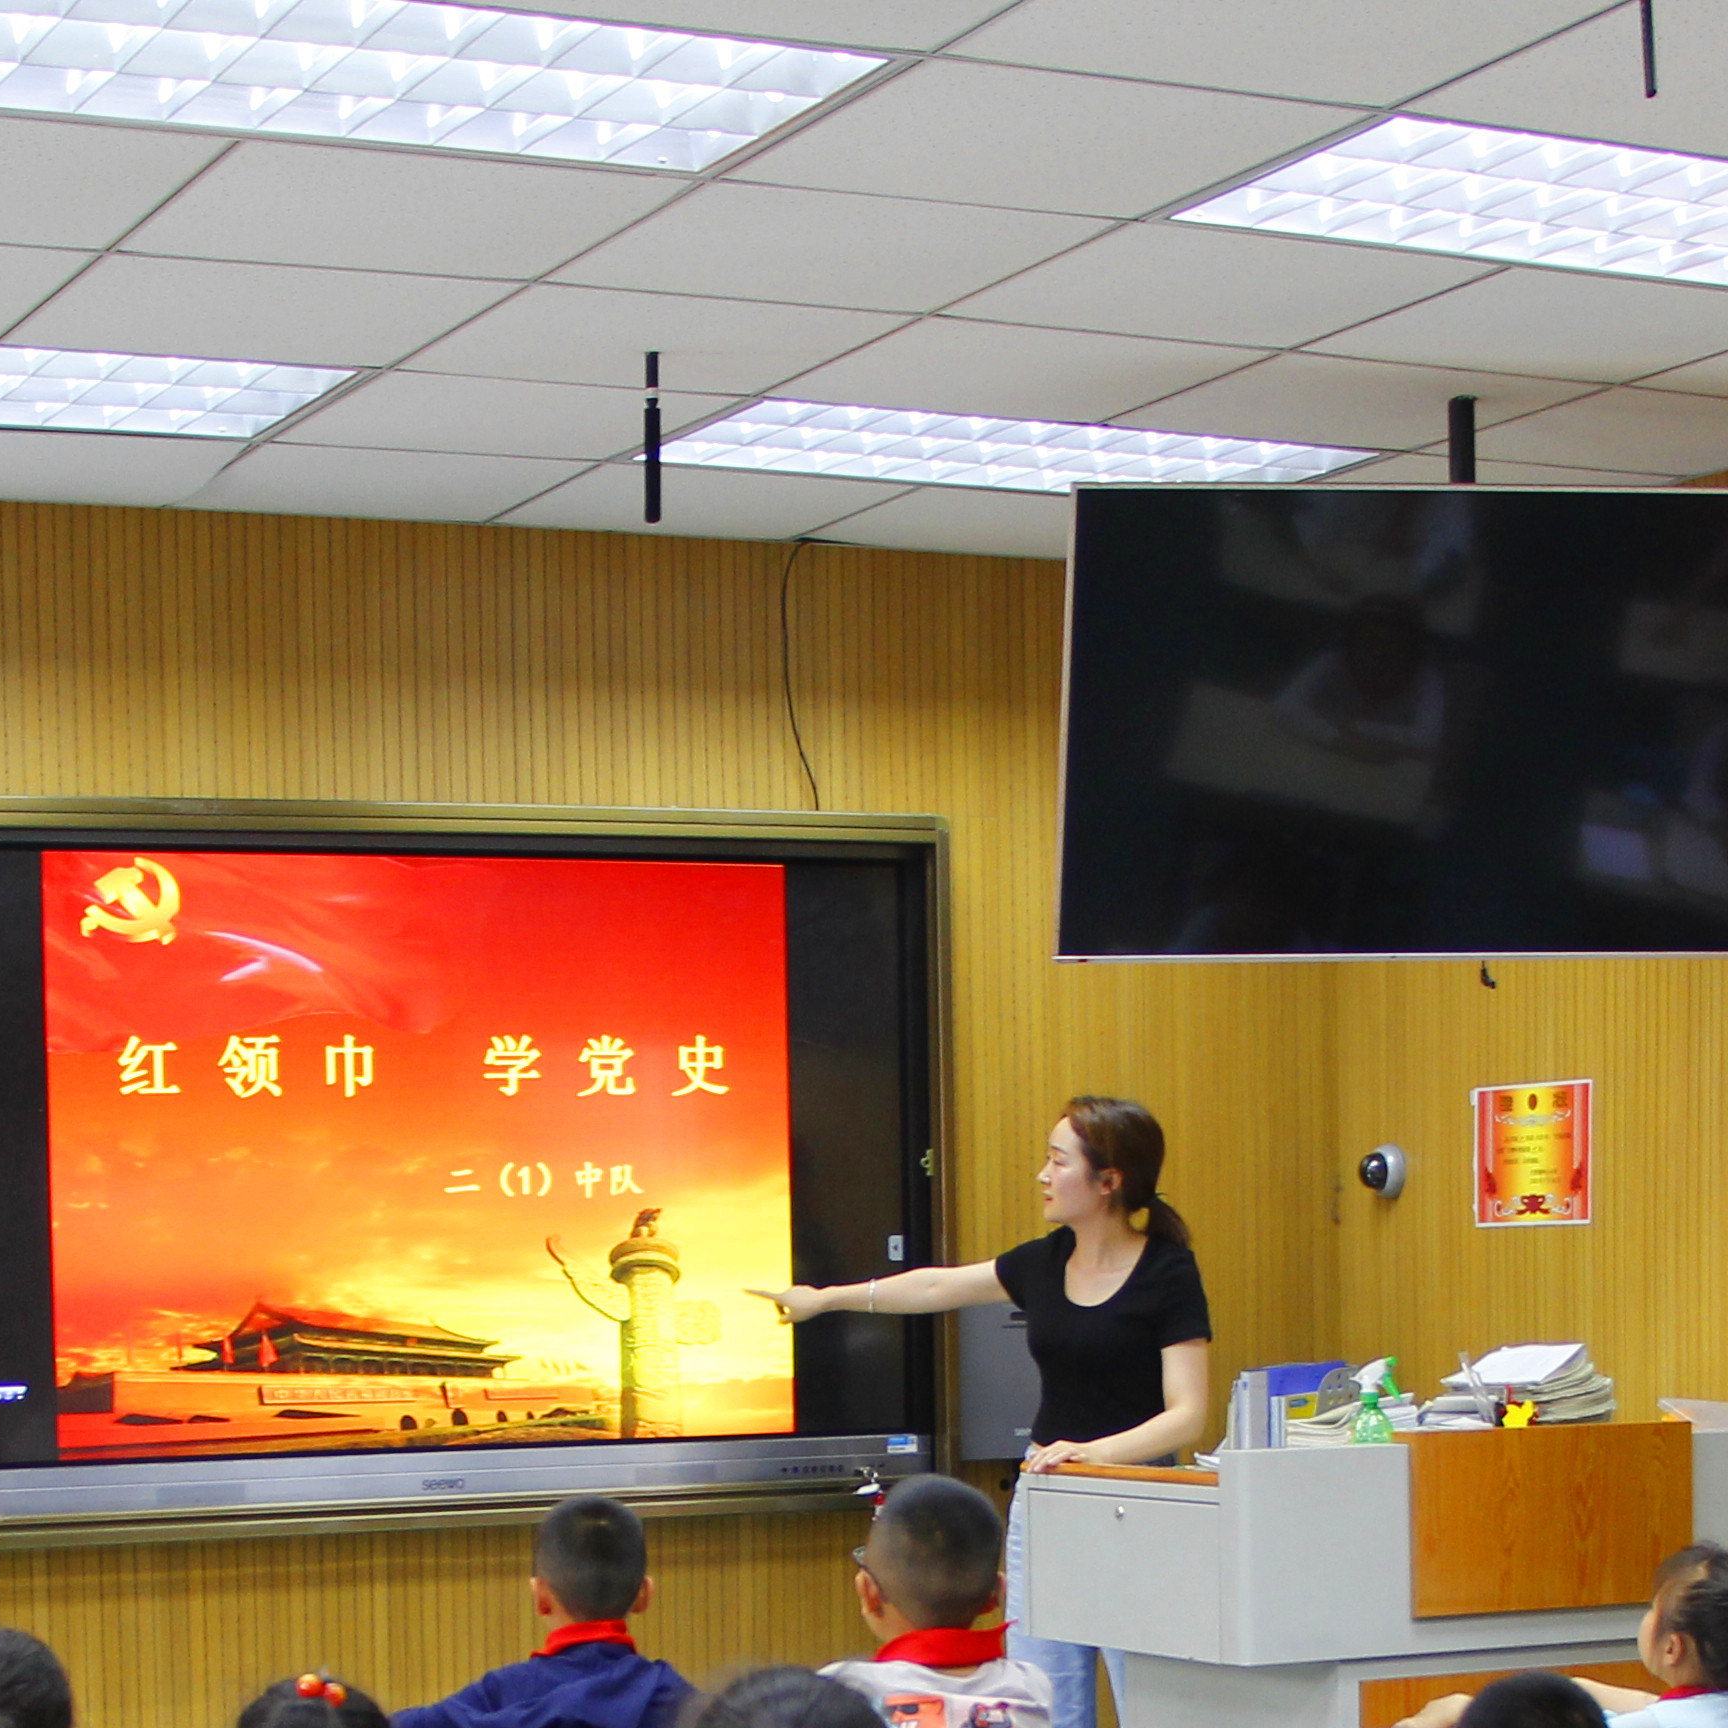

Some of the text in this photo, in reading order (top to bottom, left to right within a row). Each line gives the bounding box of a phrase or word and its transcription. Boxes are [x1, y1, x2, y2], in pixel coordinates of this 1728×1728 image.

[117, 1033, 731, 1099] 红领巾 学党史
